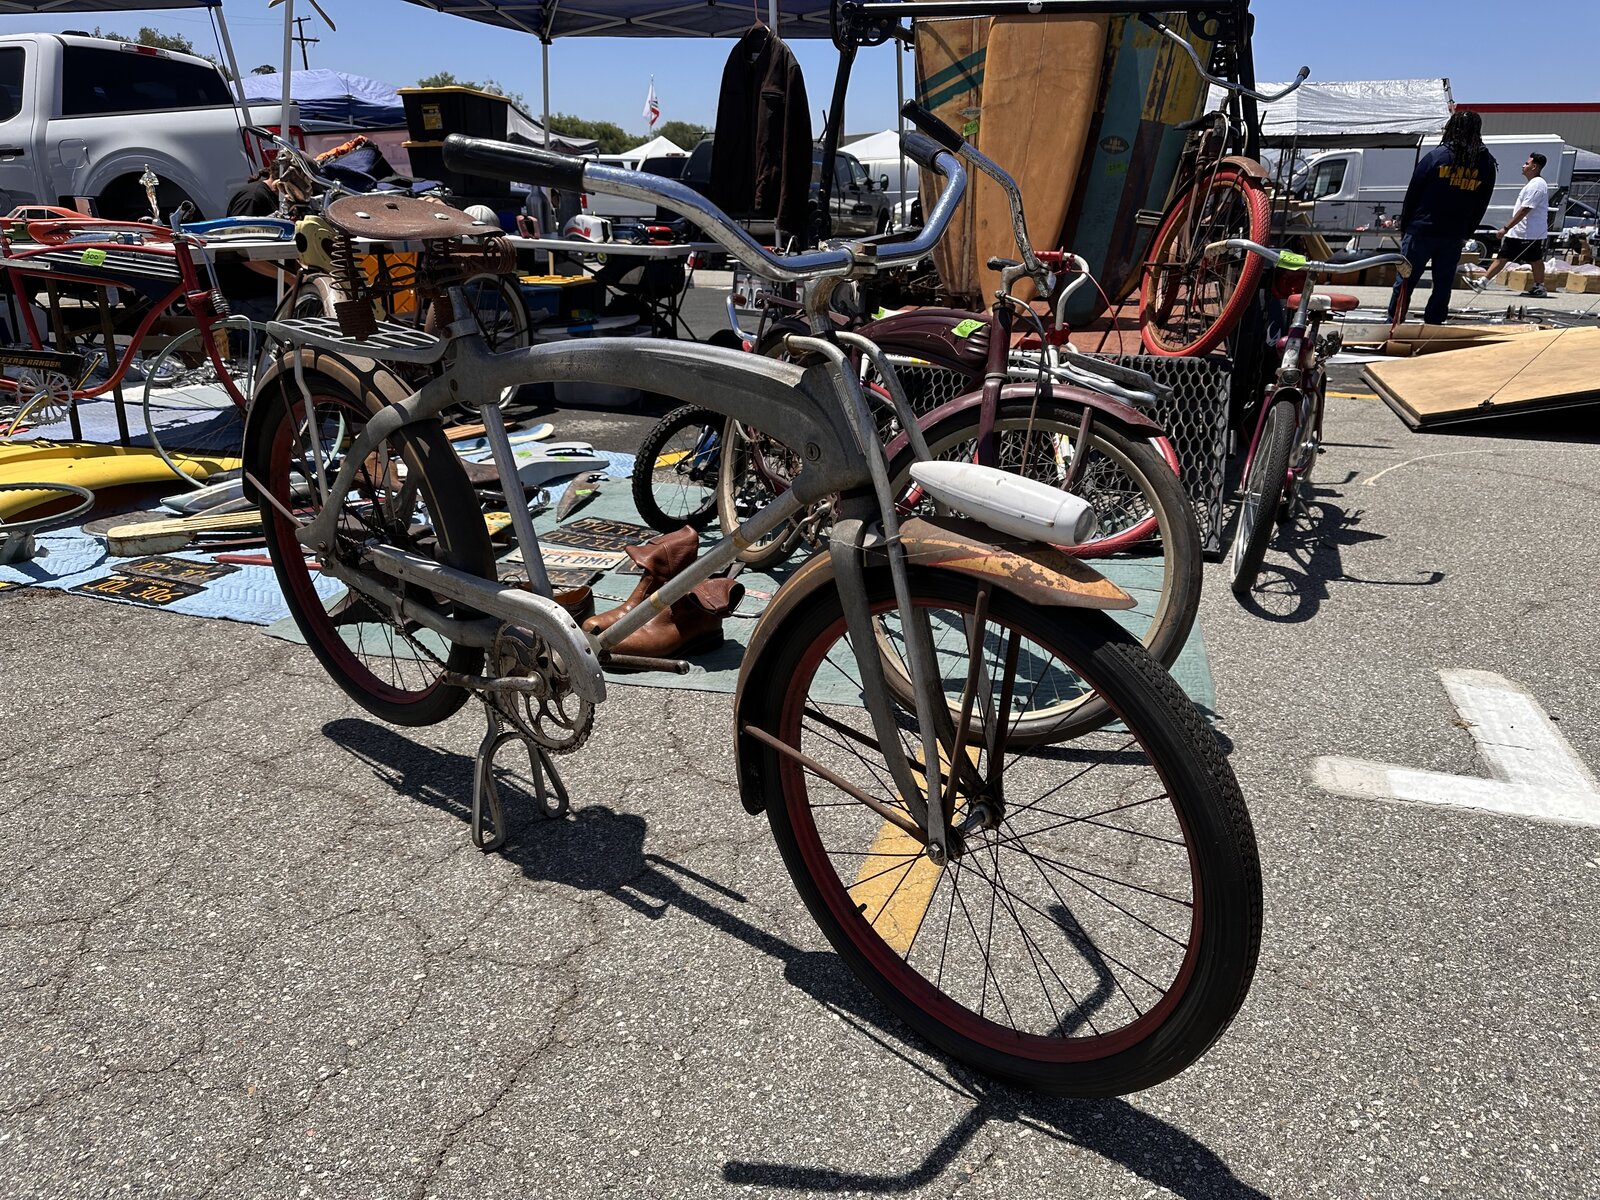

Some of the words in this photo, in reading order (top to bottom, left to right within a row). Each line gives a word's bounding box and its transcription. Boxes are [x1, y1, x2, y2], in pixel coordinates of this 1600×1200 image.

[1460, 178, 1482, 190] DAY
[0, 356, 25, 365] EXAS
[26, 359, 61, 367] RANGER
[544, 532, 590, 544] OYU
[572, 556, 615, 566] BMR
[130, 586, 184, 601] 306
